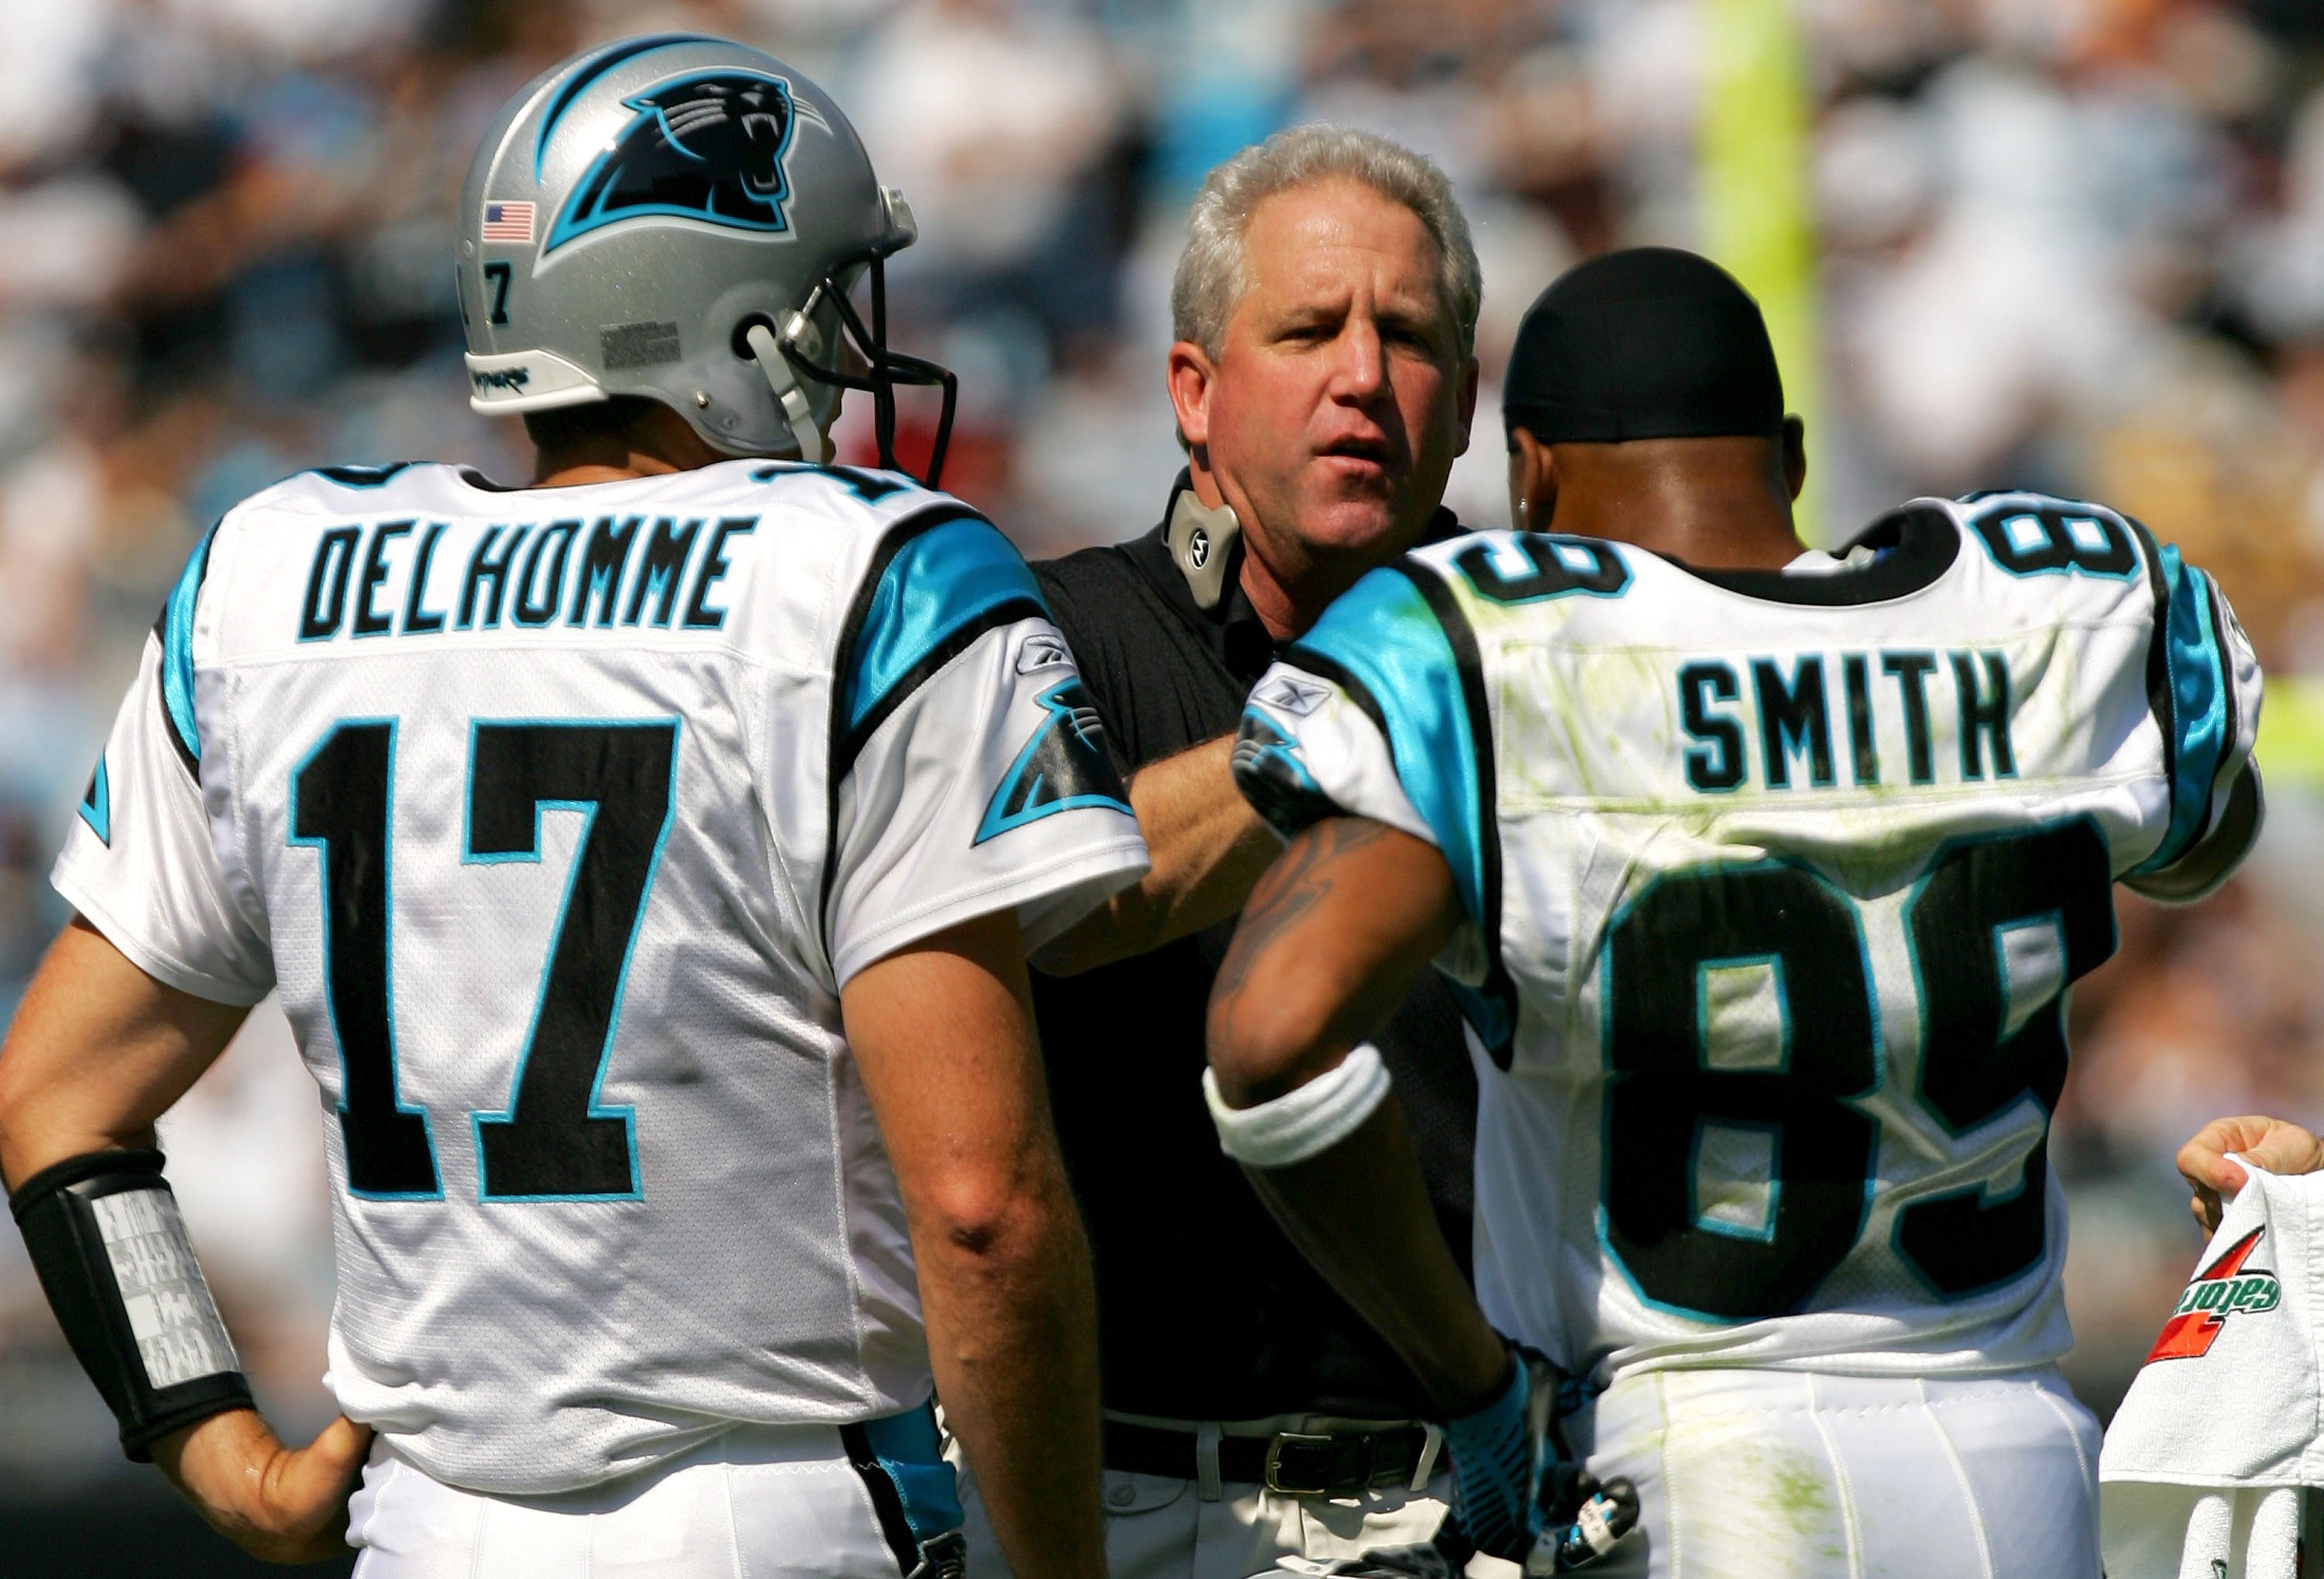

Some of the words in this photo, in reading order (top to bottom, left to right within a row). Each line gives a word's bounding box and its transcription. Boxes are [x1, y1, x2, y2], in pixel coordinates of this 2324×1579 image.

[294, 511, 758, 644] DELHOMME
[1678, 648, 2019, 794] SMITH
[286, 714, 682, 1203] 17
[1596, 811, 2119, 1326] 89
